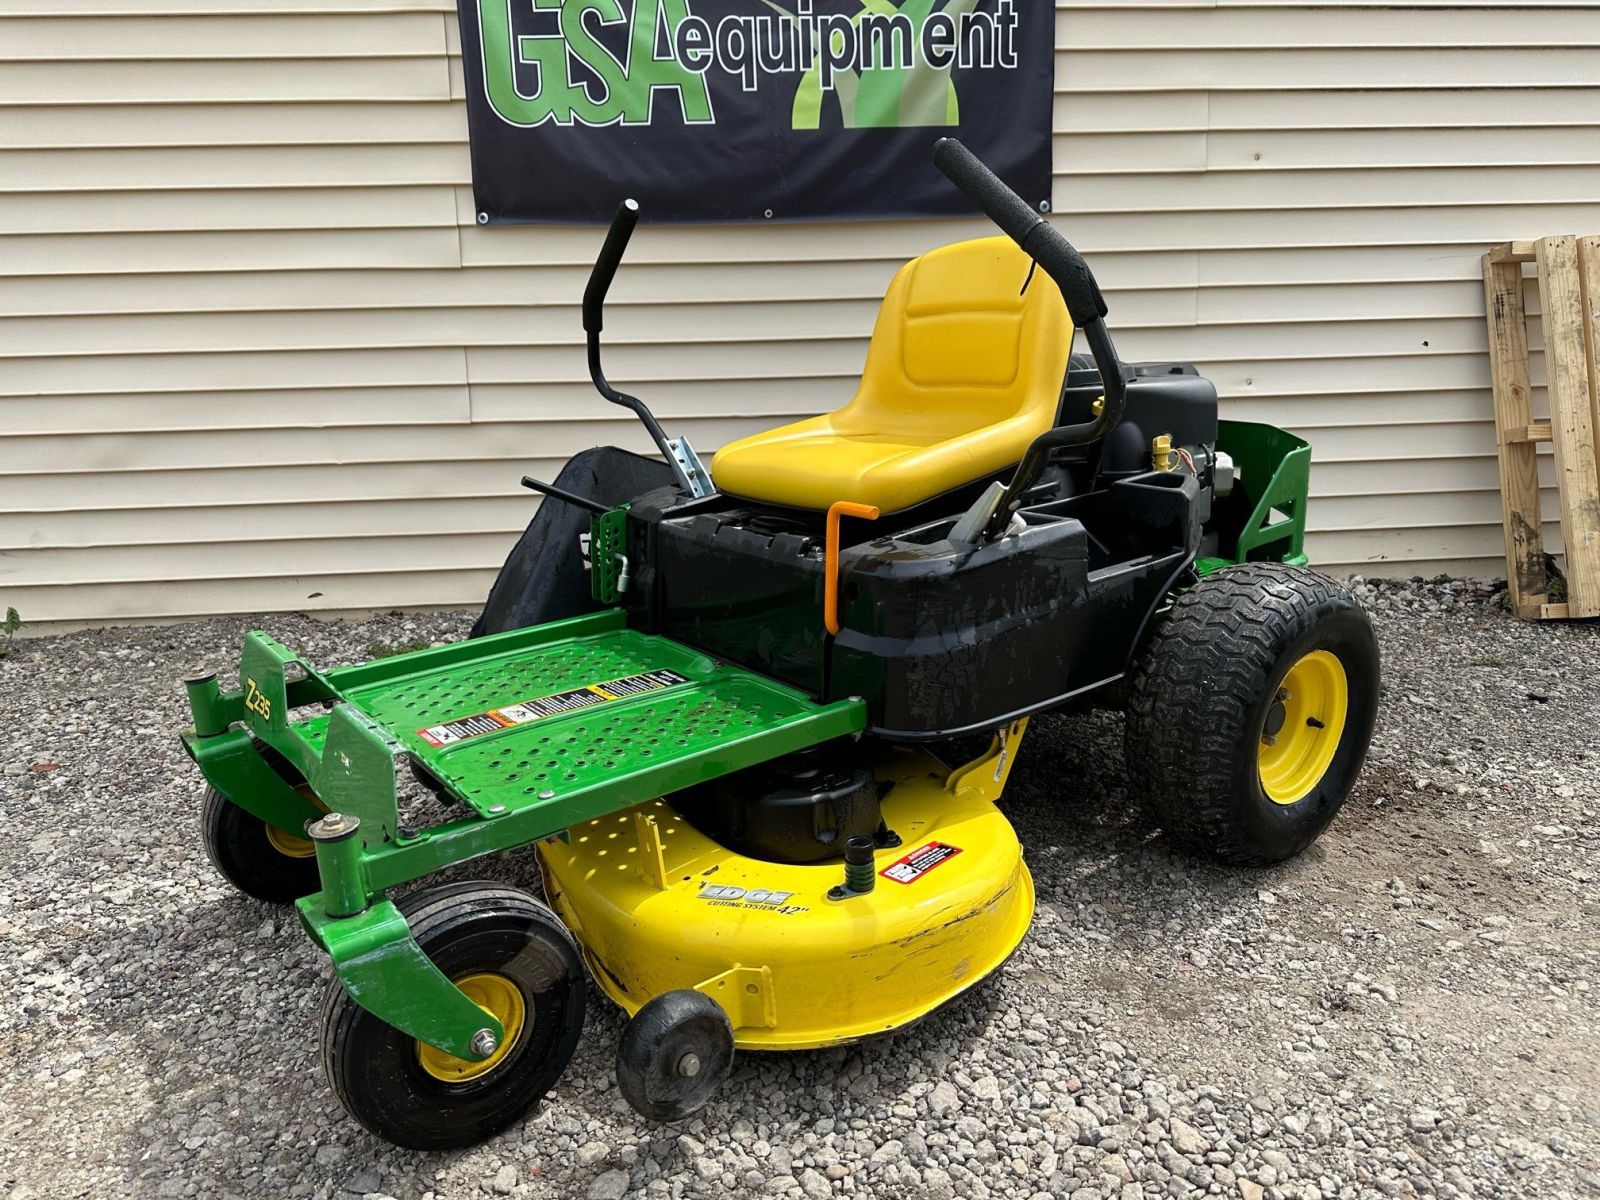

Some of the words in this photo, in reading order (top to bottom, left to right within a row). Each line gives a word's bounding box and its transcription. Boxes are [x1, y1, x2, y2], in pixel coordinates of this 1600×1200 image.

[476, 0, 715, 127] GSA
[674, 0, 1018, 92] equipment
[245, 675, 272, 721] Z235
[697, 886, 793, 905] EDGE
[707, 900, 742, 908] CUTTING
[742, 903, 778, 911] SYSTEM
[777, 905, 810, 915] 42"
